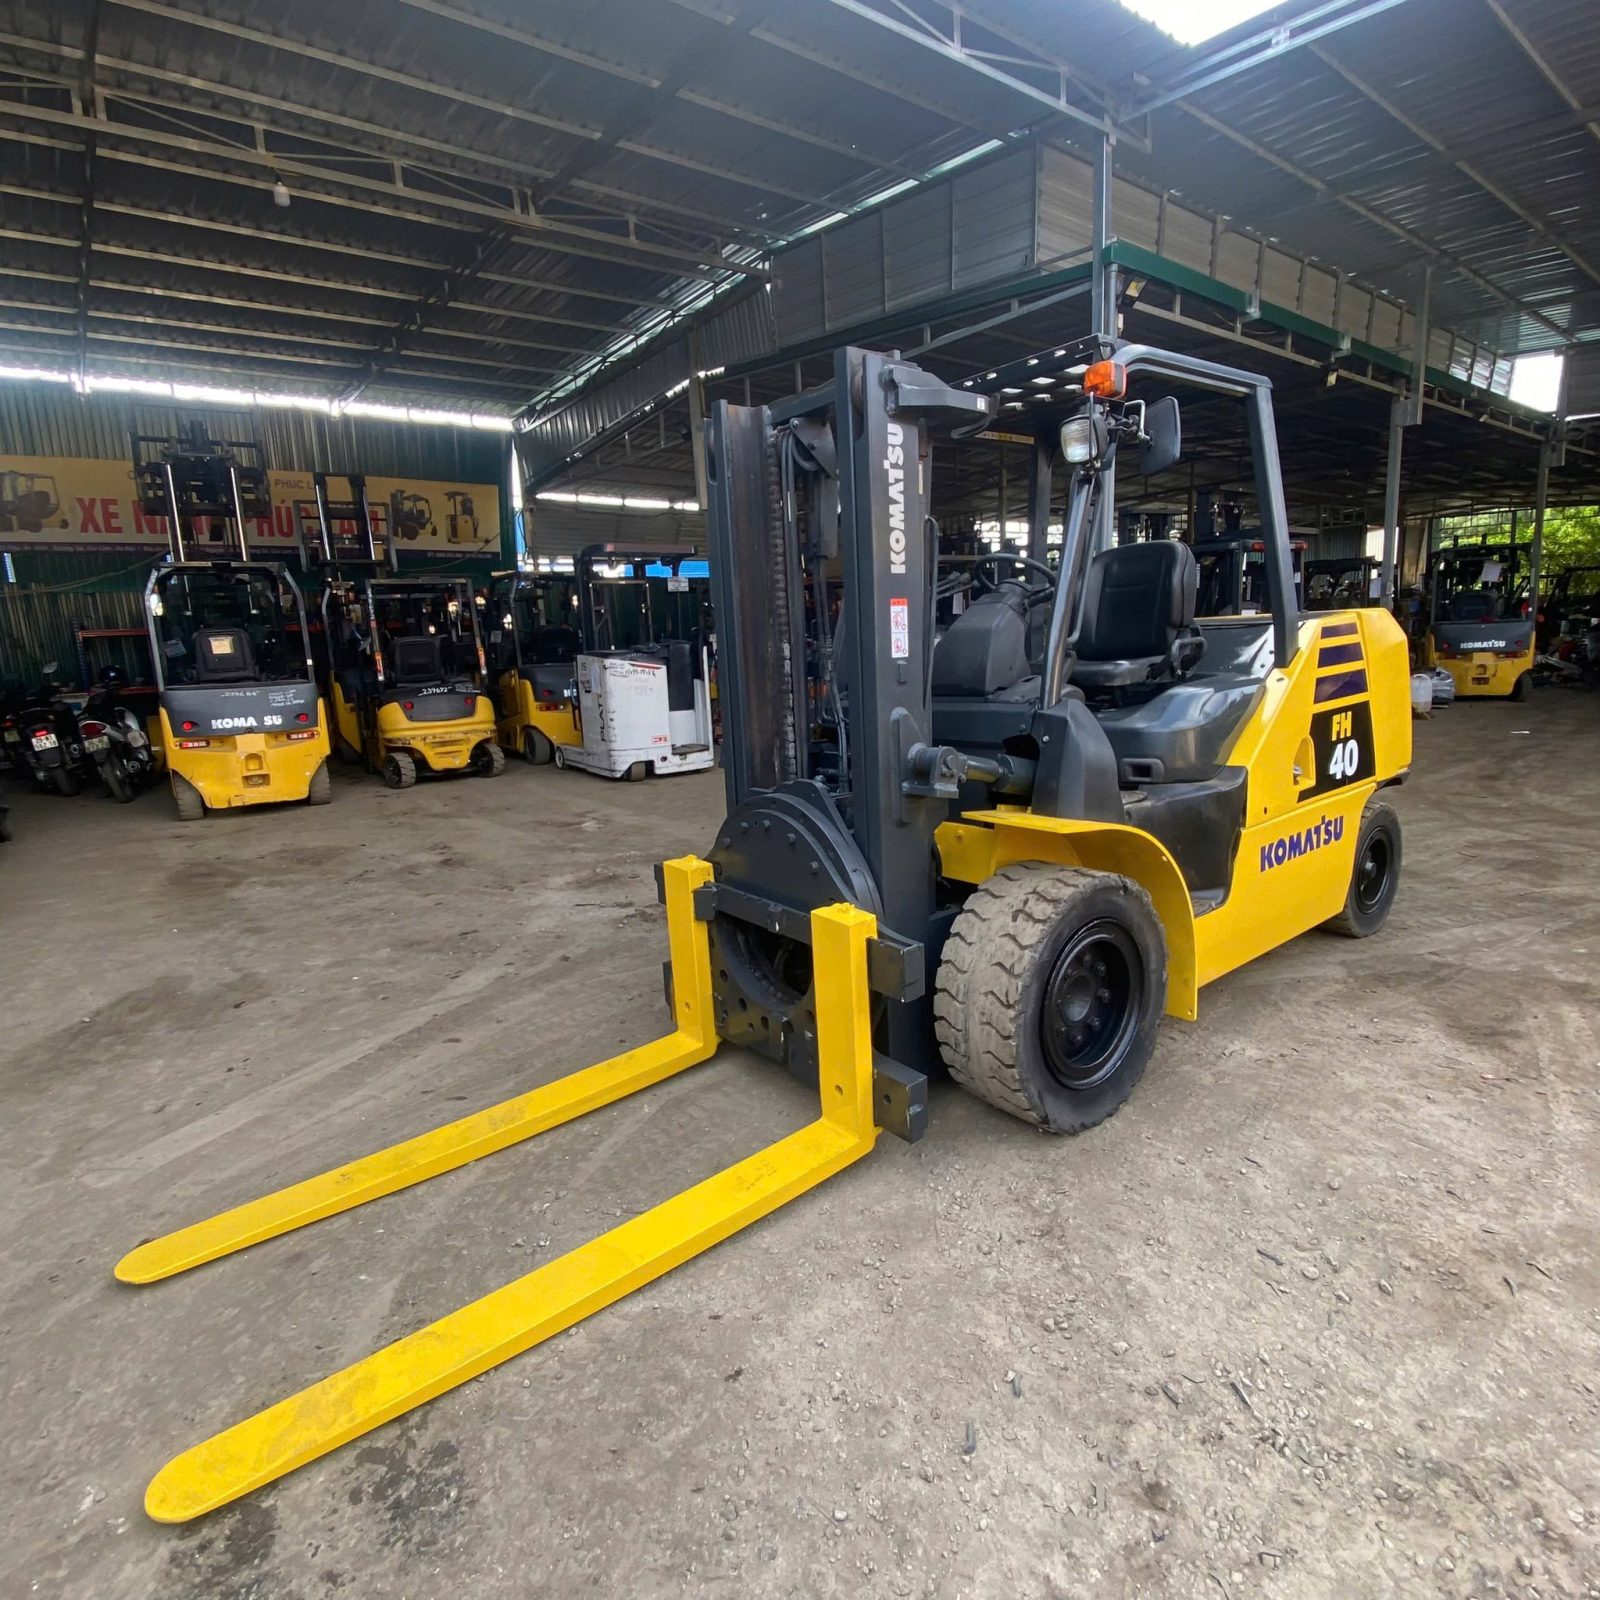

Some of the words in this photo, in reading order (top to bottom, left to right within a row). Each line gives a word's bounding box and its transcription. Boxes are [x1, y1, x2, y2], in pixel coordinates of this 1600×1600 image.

[76, 496, 123, 534] XE
[883, 422, 906, 574] KOMATSU
[1460, 639, 1506, 649] KOMATSU
[1331, 711, 1352, 742] FH
[1328, 738, 1359, 780] 40
[1260, 814, 1344, 873] KOMATSU
